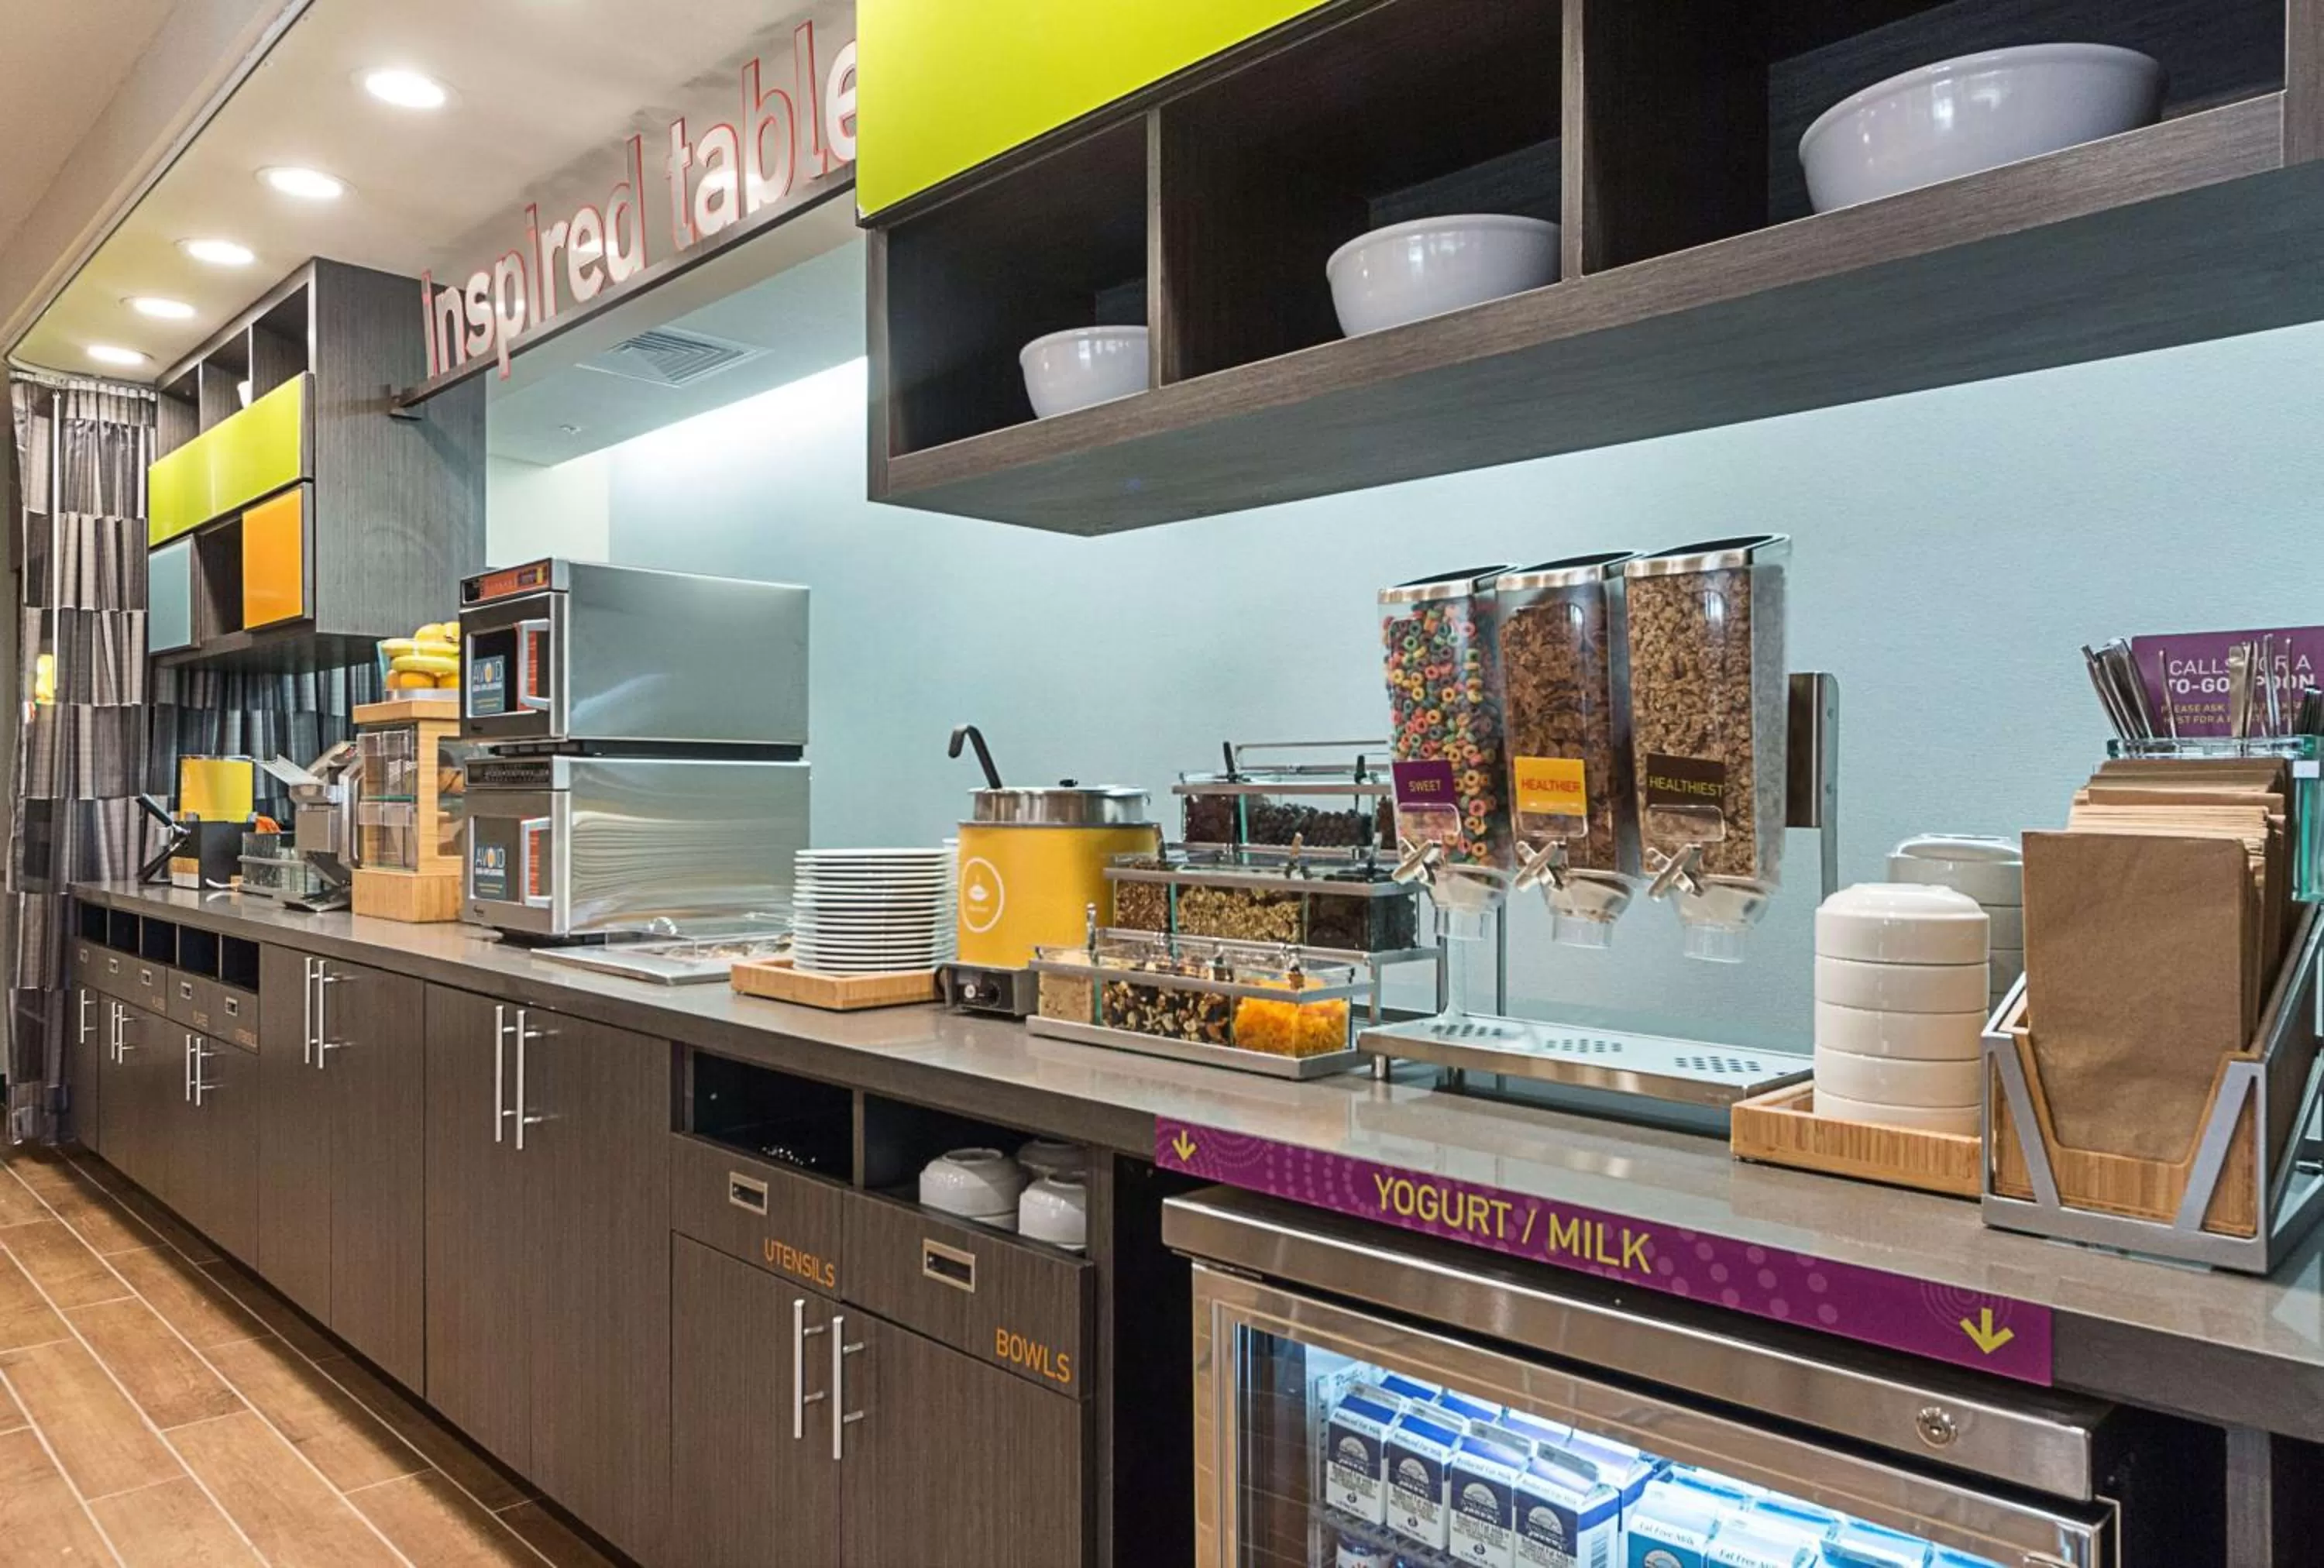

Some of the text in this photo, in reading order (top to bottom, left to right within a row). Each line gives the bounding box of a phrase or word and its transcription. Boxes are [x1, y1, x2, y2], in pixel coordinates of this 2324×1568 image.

[664, 19, 856, 251] table
[2295, 655, 2312, 670] A
[1408, 779, 1442, 793] SWEET
[1521, 777, 1582, 794] HEALTHIER
[1648, 775, 1725, 799] HEALTHIEST
[1373, 1174, 1652, 1274] YOGURT / MILK
[764, 1239, 835, 1288] UTENSILS
[995, 1327, 1071, 1383] BOWLS
